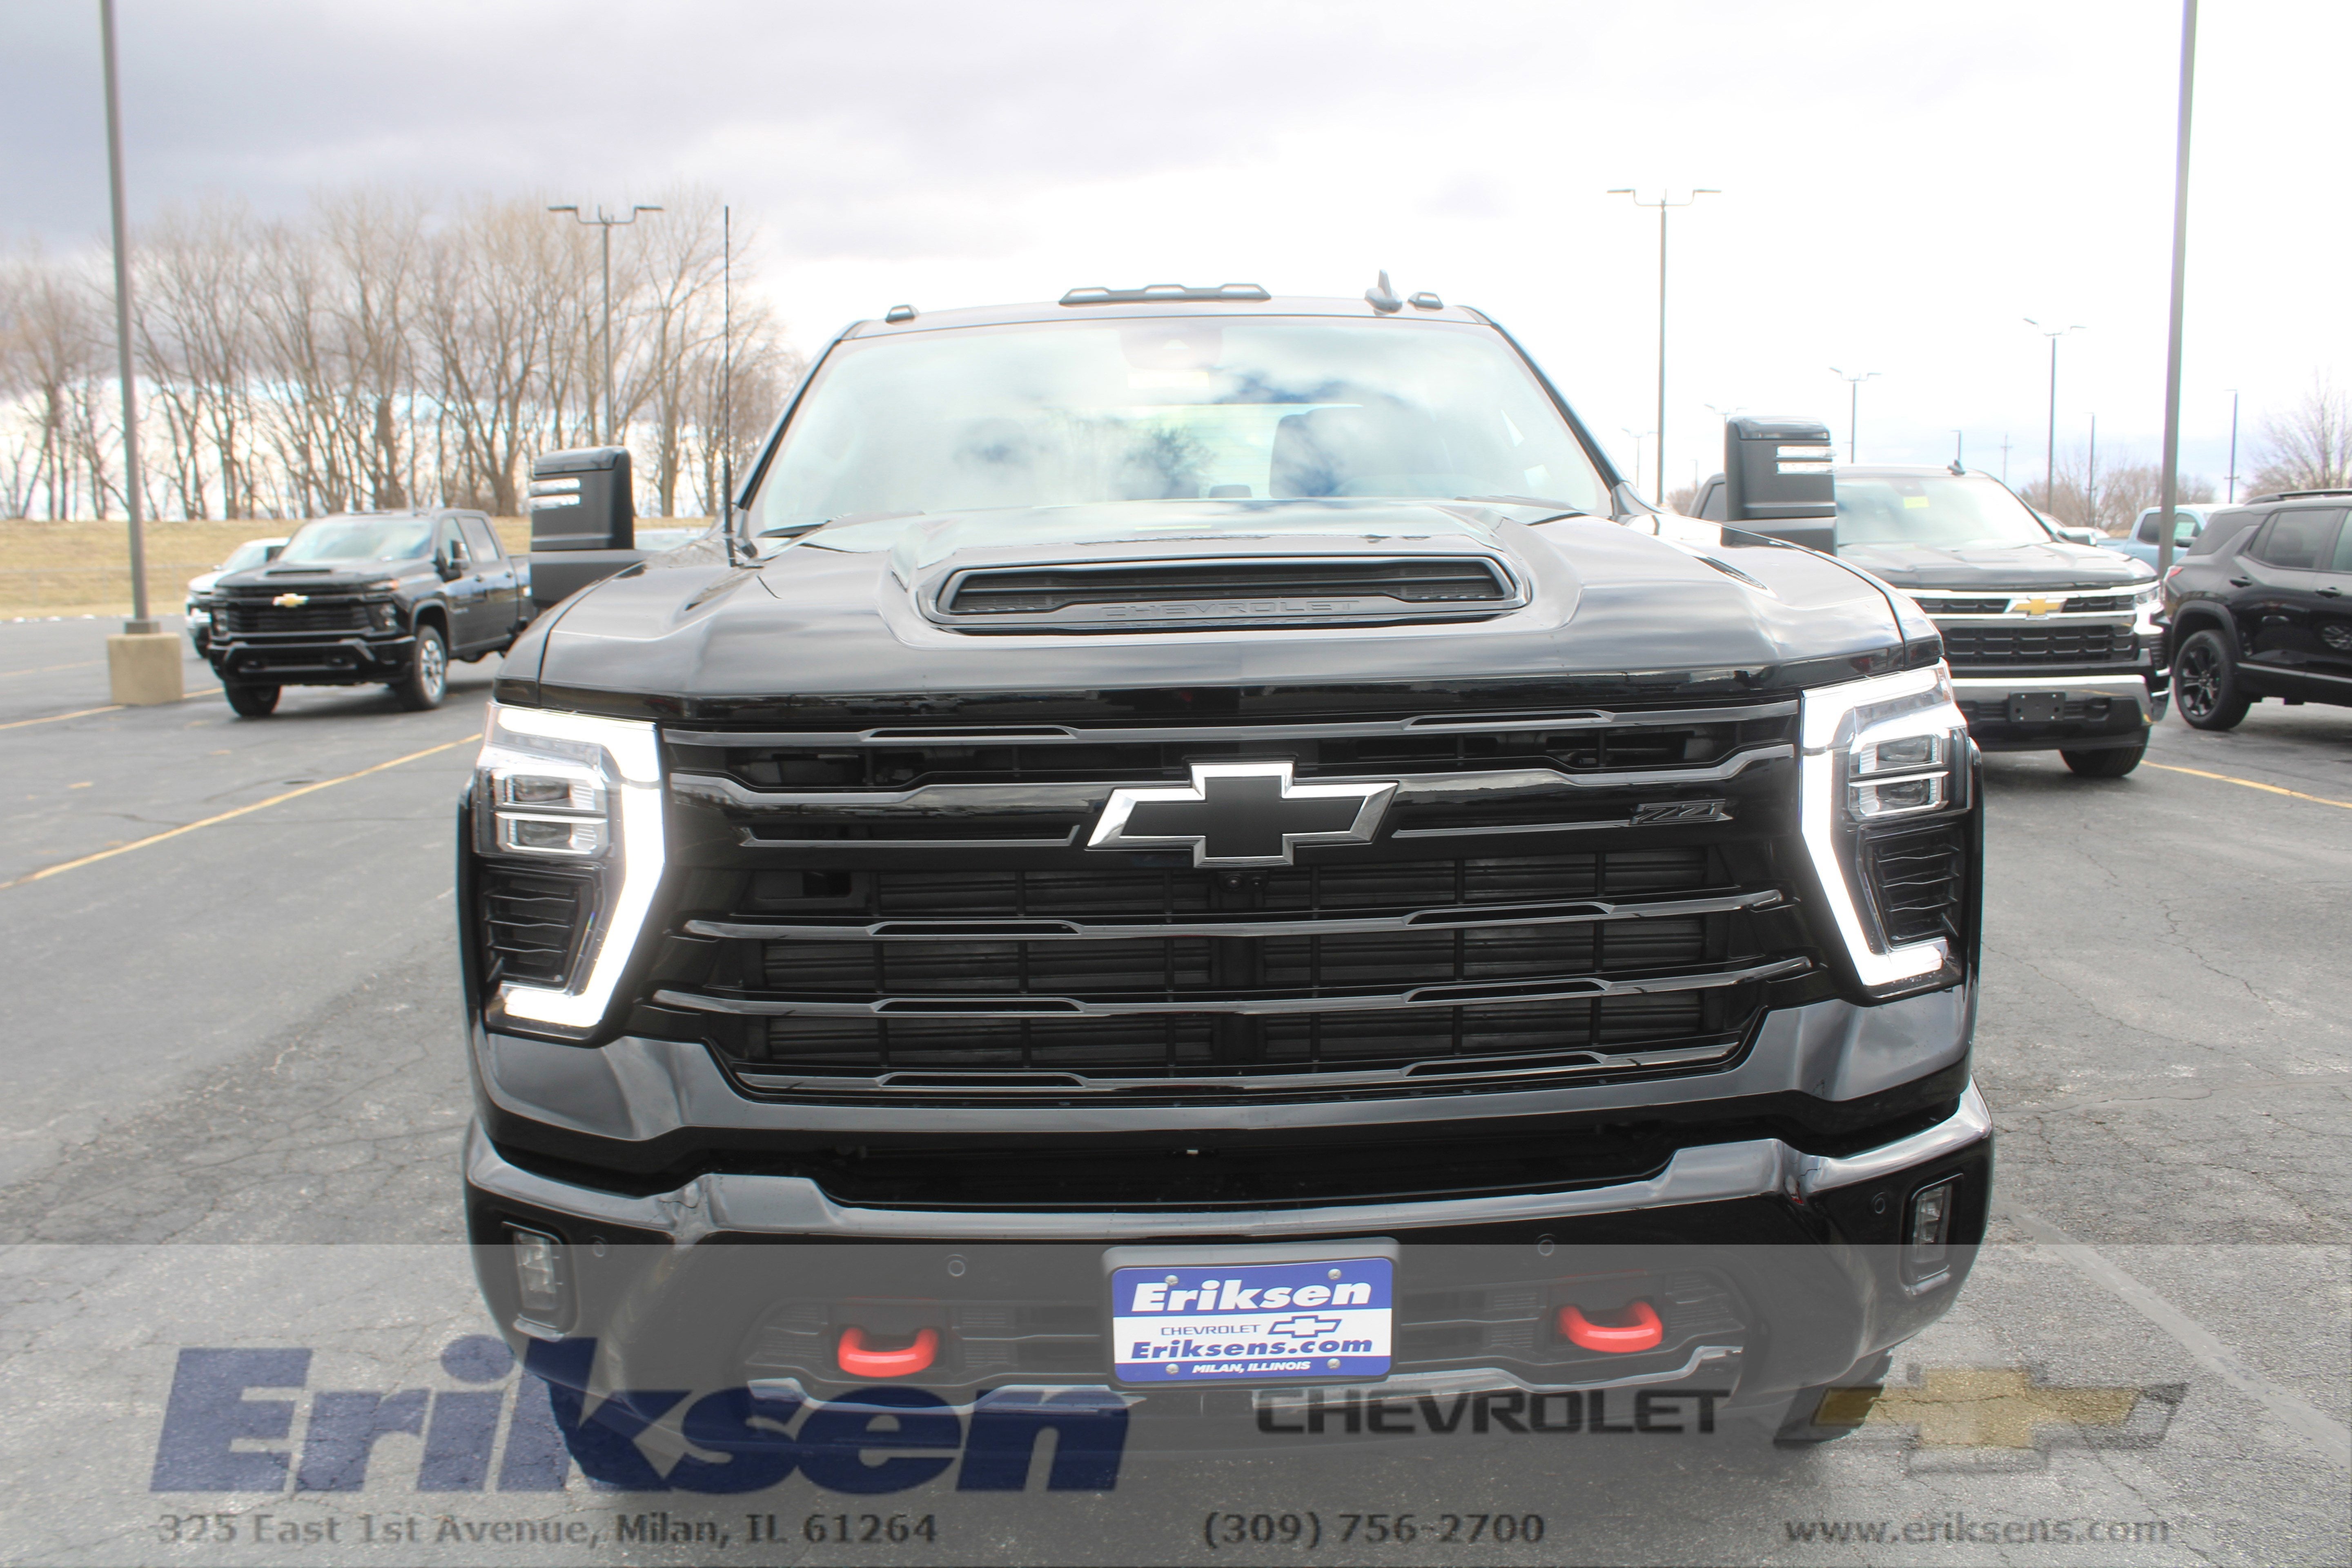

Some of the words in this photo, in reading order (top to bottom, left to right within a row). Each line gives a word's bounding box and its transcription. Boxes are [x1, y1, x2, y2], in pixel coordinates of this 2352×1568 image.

[1101, 600, 1360, 617] CHEVROLET
[1131, 1279, 1372, 1312] Eriksen
[1161, 1324, 1261, 1336] CHEVROLET
[1131, 1339, 1372, 1359] Eriksens.com
[1192, 1363, 1245, 1374] MILAN,
[1247, 1361, 1311, 1372] ILLINOIS
